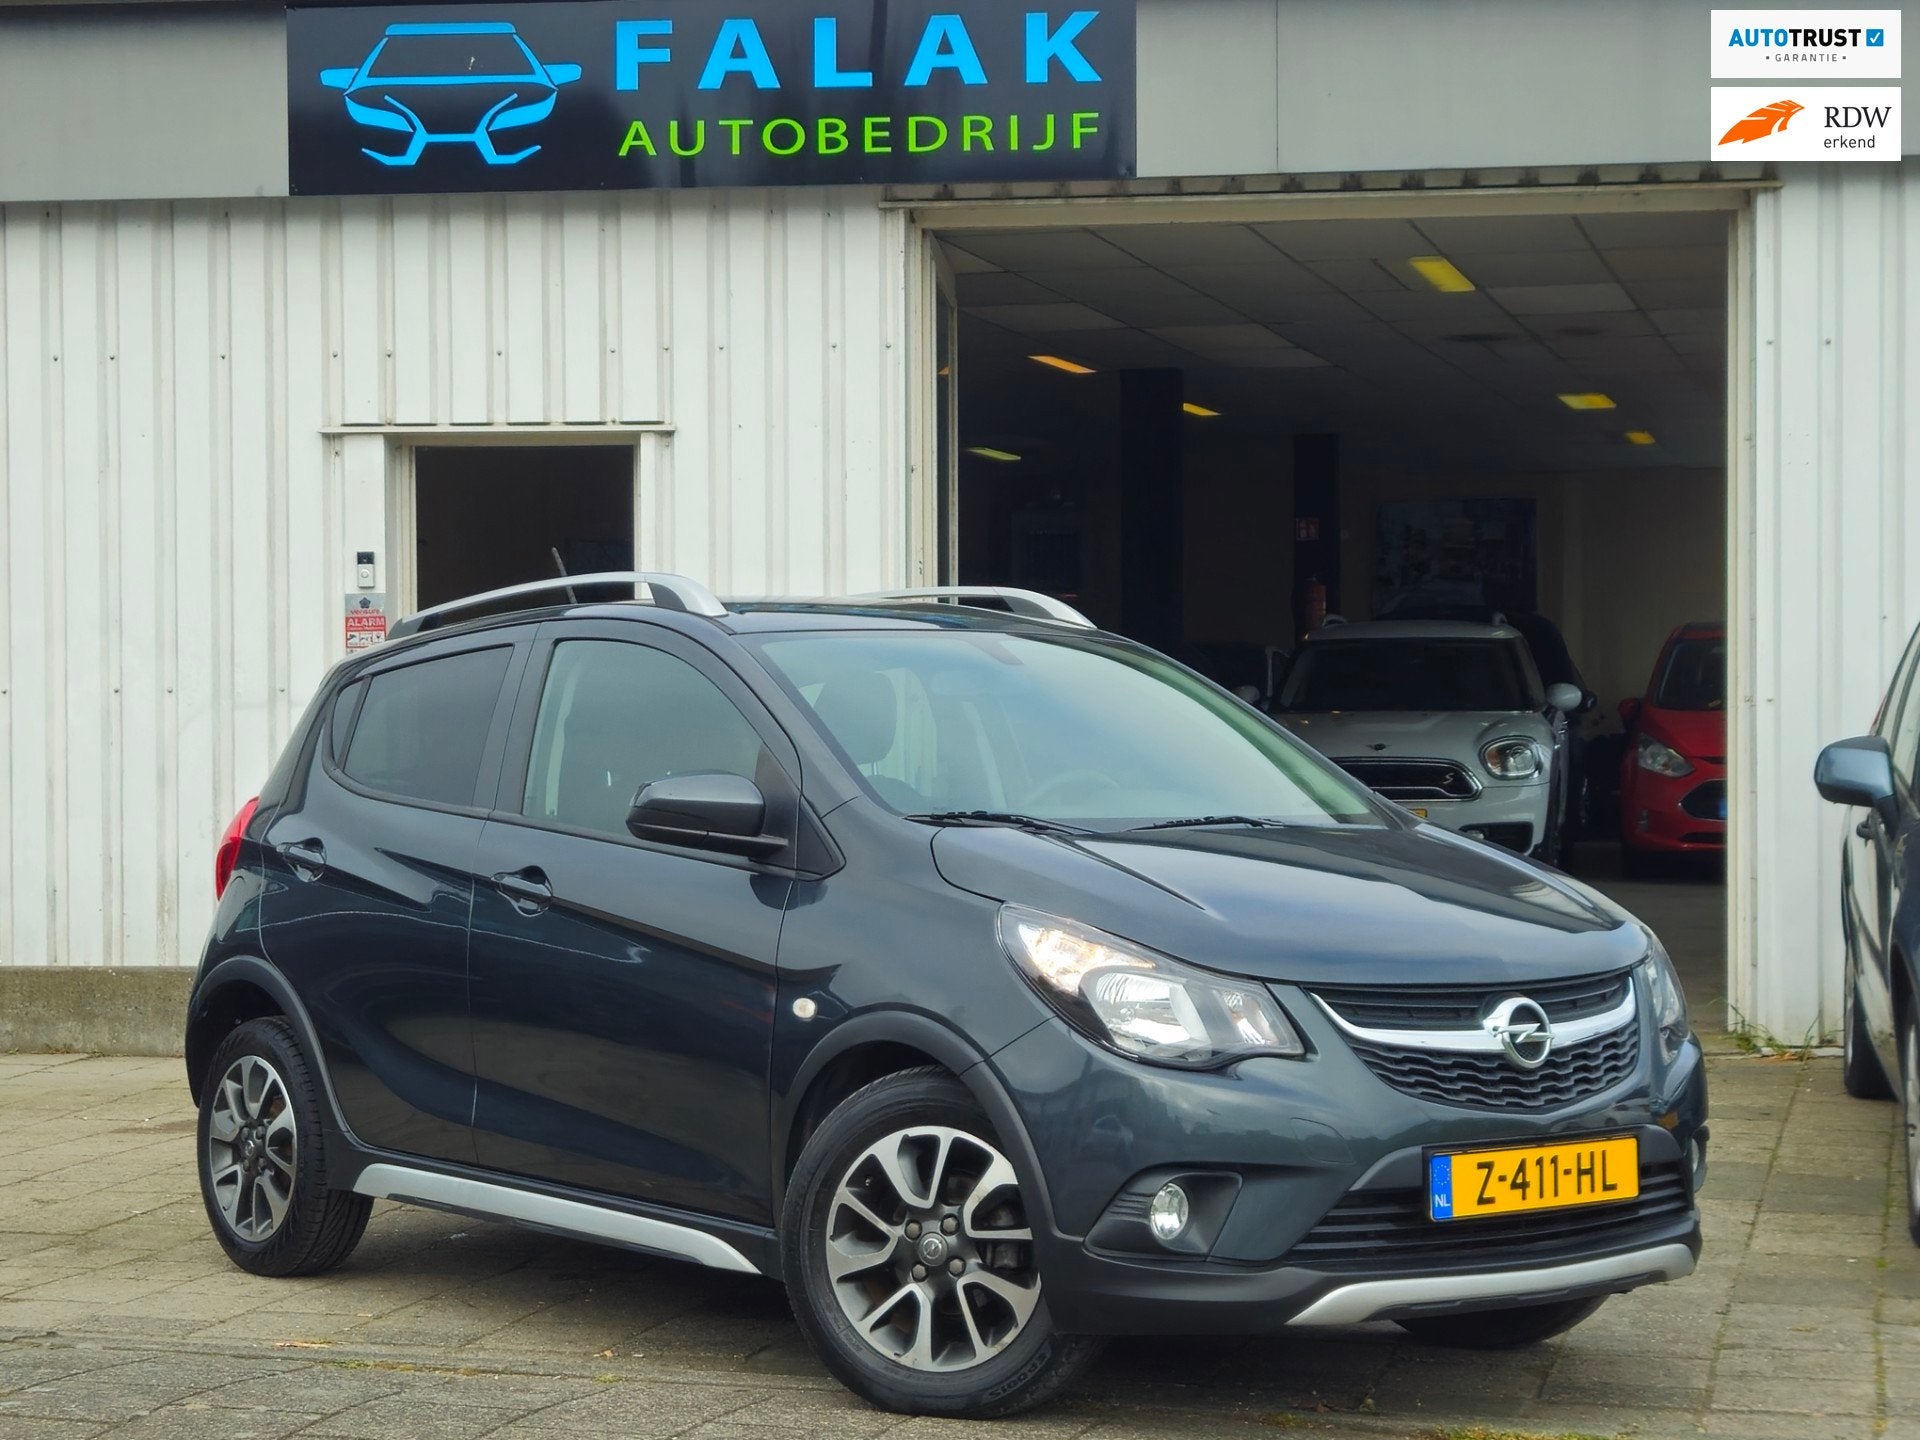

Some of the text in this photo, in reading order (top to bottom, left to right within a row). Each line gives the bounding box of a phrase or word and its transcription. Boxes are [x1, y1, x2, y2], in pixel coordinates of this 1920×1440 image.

[617, 11, 1100, 90] FALAK
[619, 113, 1099, 156] AUTOBEDRIJF
[347, 617, 385, 627] ALARM
[1476, 1150, 1618, 1206] Z-411-HL
[1434, 1194, 1450, 1208] NL
